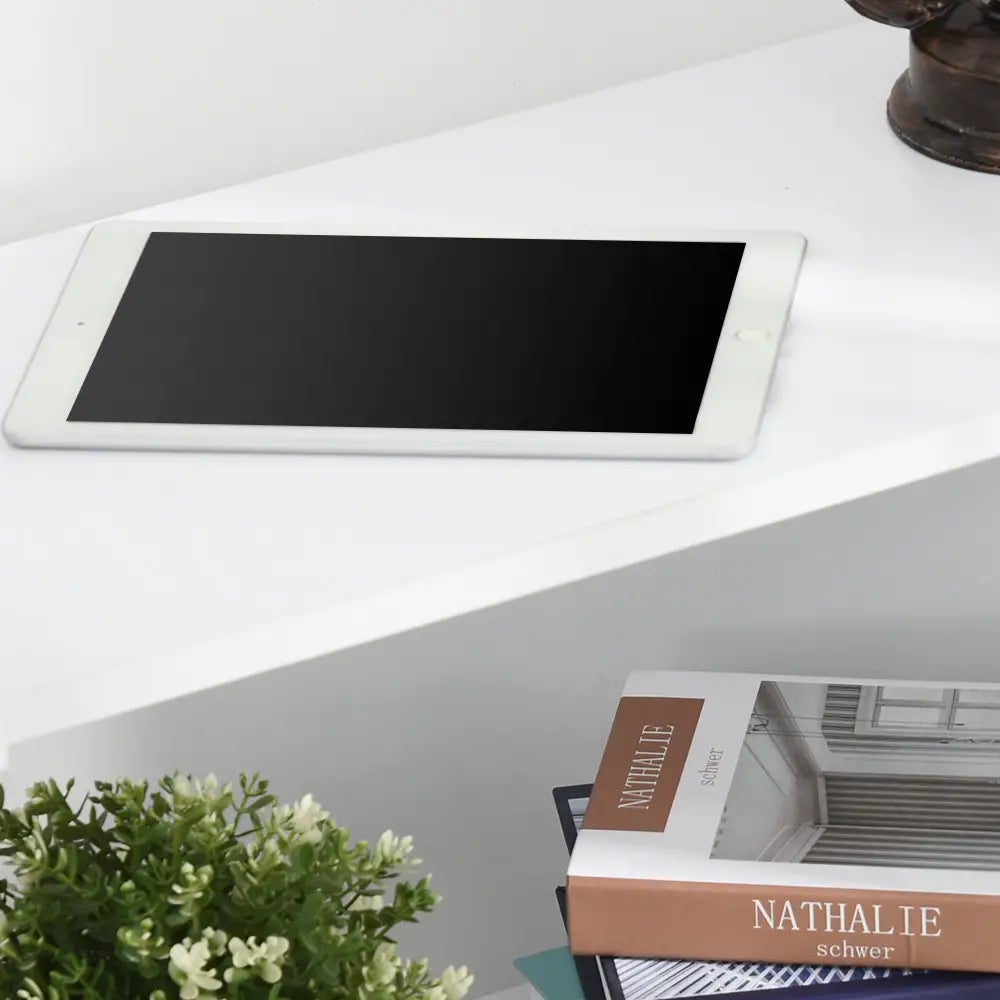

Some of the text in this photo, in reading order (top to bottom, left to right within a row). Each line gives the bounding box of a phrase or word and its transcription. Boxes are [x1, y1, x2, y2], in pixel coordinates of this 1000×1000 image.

[618, 724, 675, 810] NATHALIE
[700, 747, 724, 786] schwer
[752, 899, 942, 937] NATHALIE
[816, 940, 895, 960] schwer
